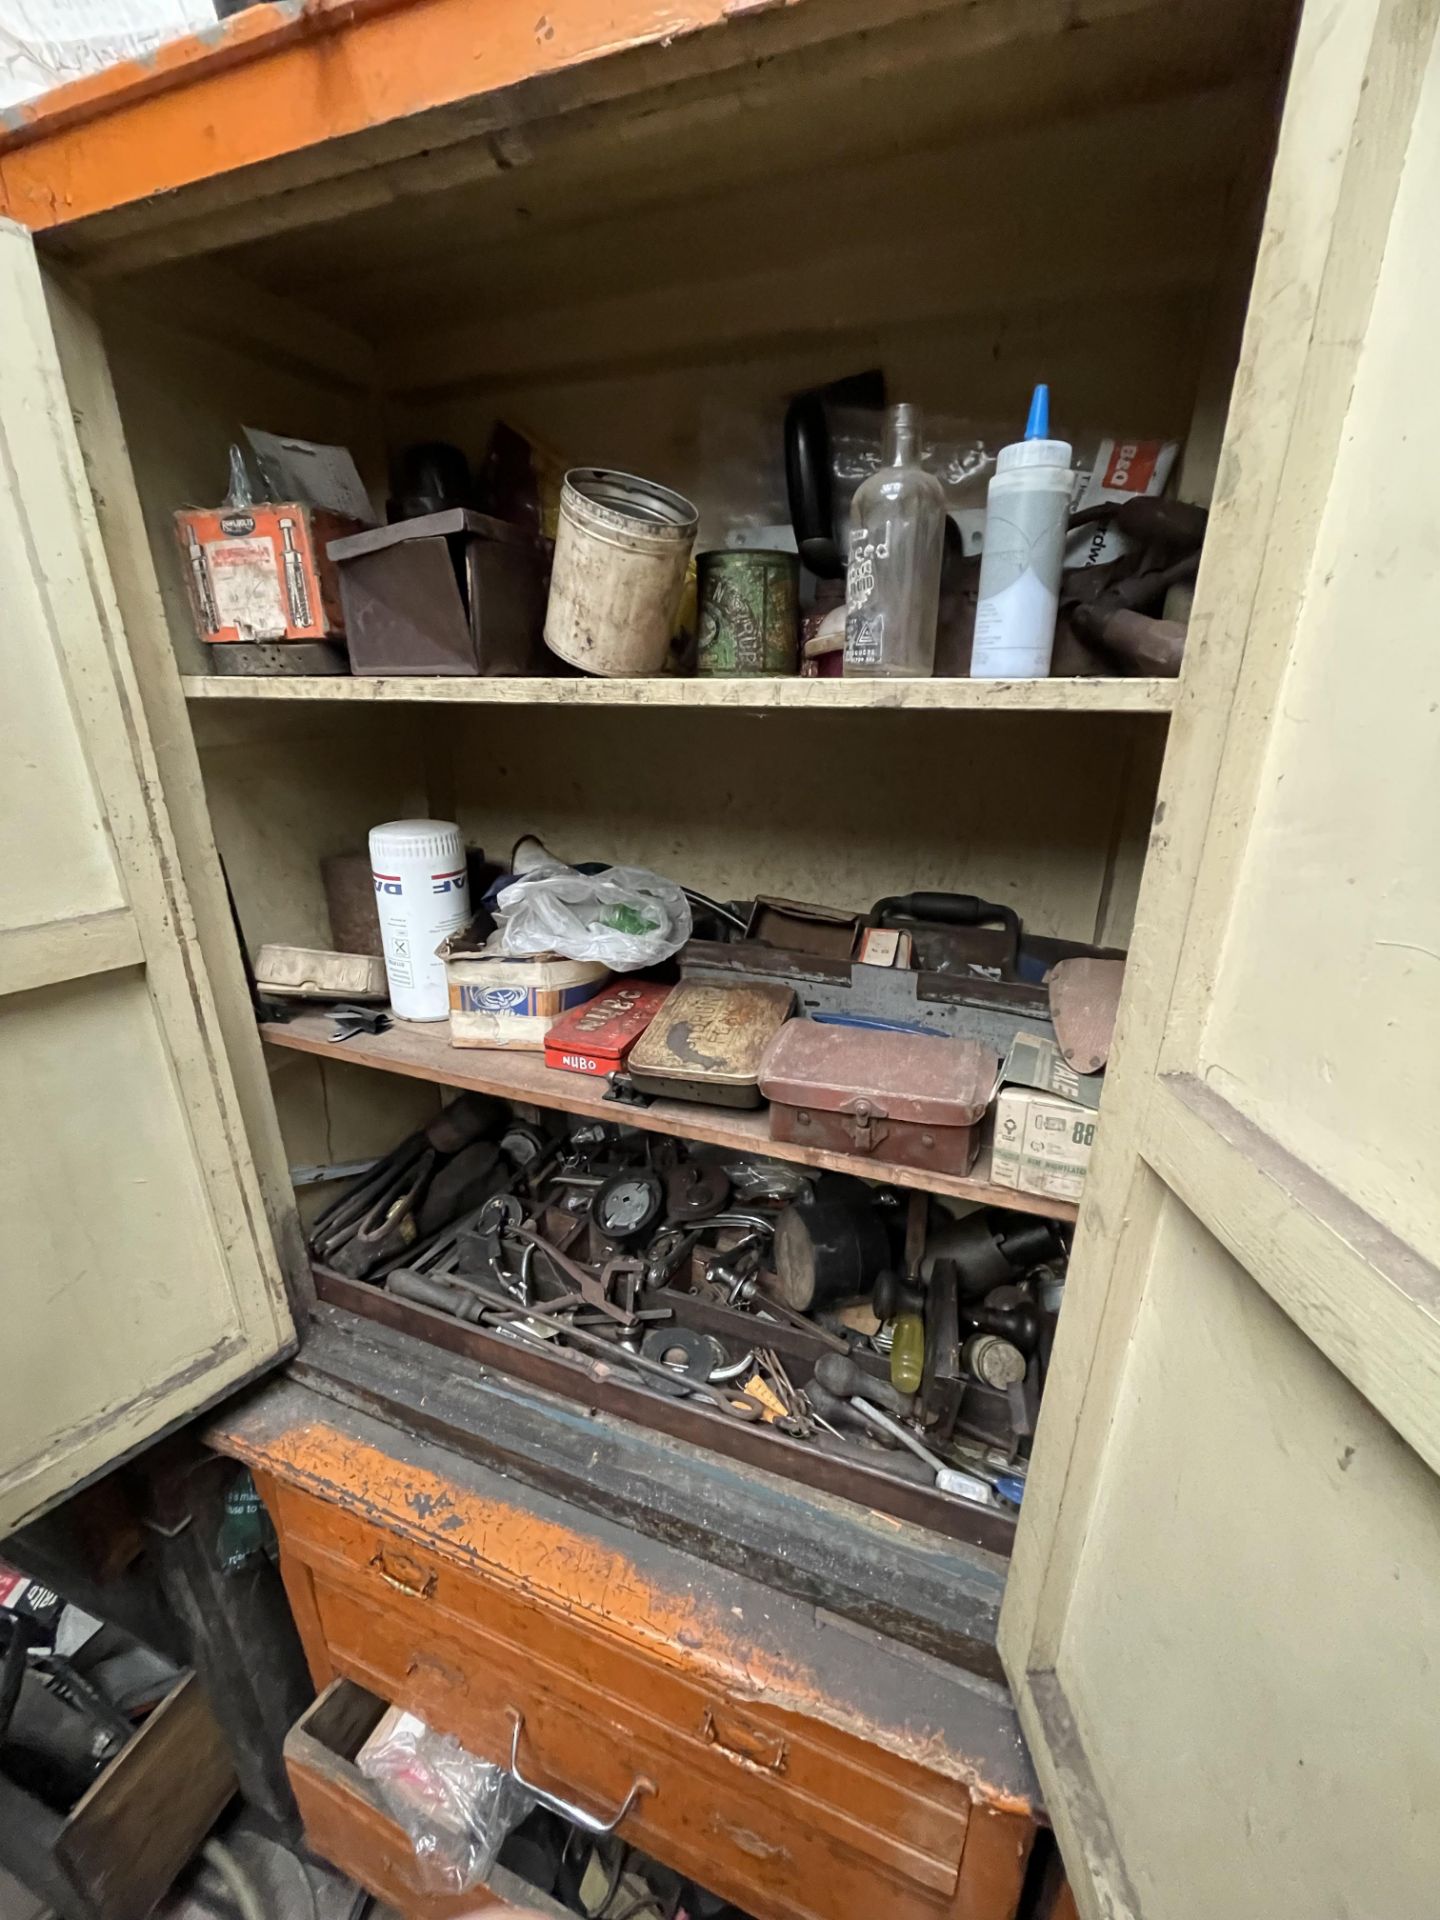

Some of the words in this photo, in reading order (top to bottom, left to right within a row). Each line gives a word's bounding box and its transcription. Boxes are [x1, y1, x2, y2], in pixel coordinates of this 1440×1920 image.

[1111, 444, 1138, 487] B&Q
[562, 1055, 597, 1071] NUBO
[1071, 1121, 1096, 1147] 88
